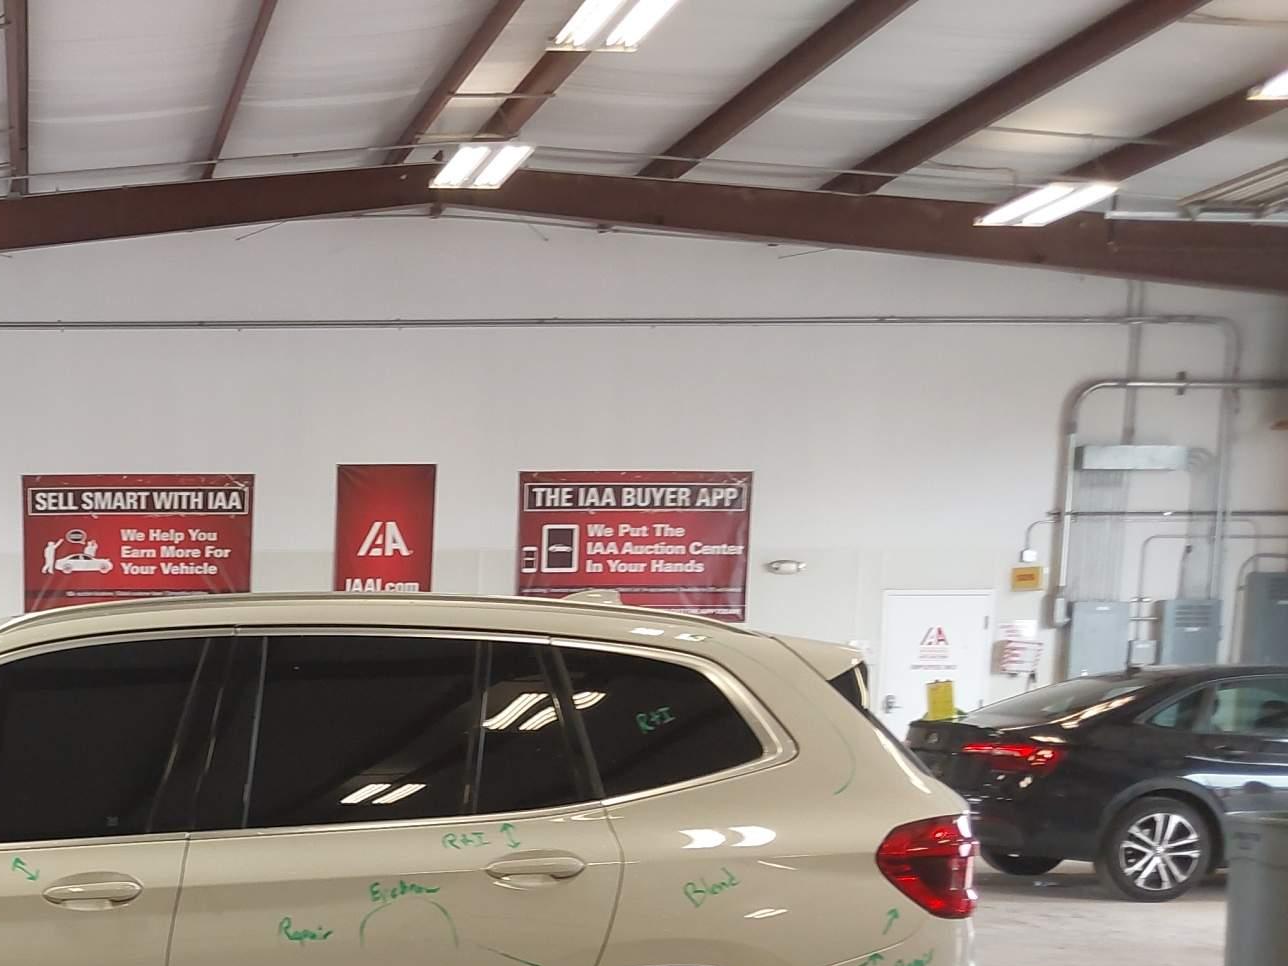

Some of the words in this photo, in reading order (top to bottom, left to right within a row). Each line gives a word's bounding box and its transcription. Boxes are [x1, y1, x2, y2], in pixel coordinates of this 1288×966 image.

[34, 491, 79, 511] SELL
[81, 491, 154, 510] SMART
[154, 491, 203, 510] WITH
[208, 491, 243, 510] IAA
[532, 487, 574, 507] THE
[579, 487, 613, 507] IAA
[621, 487, 691, 507] BUYER
[696, 487, 739, 507] APP
[120, 529, 146, 542] We
[149, 529, 185, 544] Help
[188, 529, 218, 542] You
[587, 524, 614, 537] We
[619, 524, 650, 537] Put
[653, 524, 686, 537] The
[120, 546, 157, 558] Earn
[161, 546, 201, 558] More
[205, 546, 232, 558] For
[586, 542, 619, 555] IAA
[621, 542, 686, 555] Auction
[689, 542, 744, 555] Center
[120, 563, 157, 575] Your
[161, 563, 218, 575] Vehicle
[586, 560, 603, 573] In
[607, 560, 648, 573] Your
[651, 560, 705, 573] Hands
